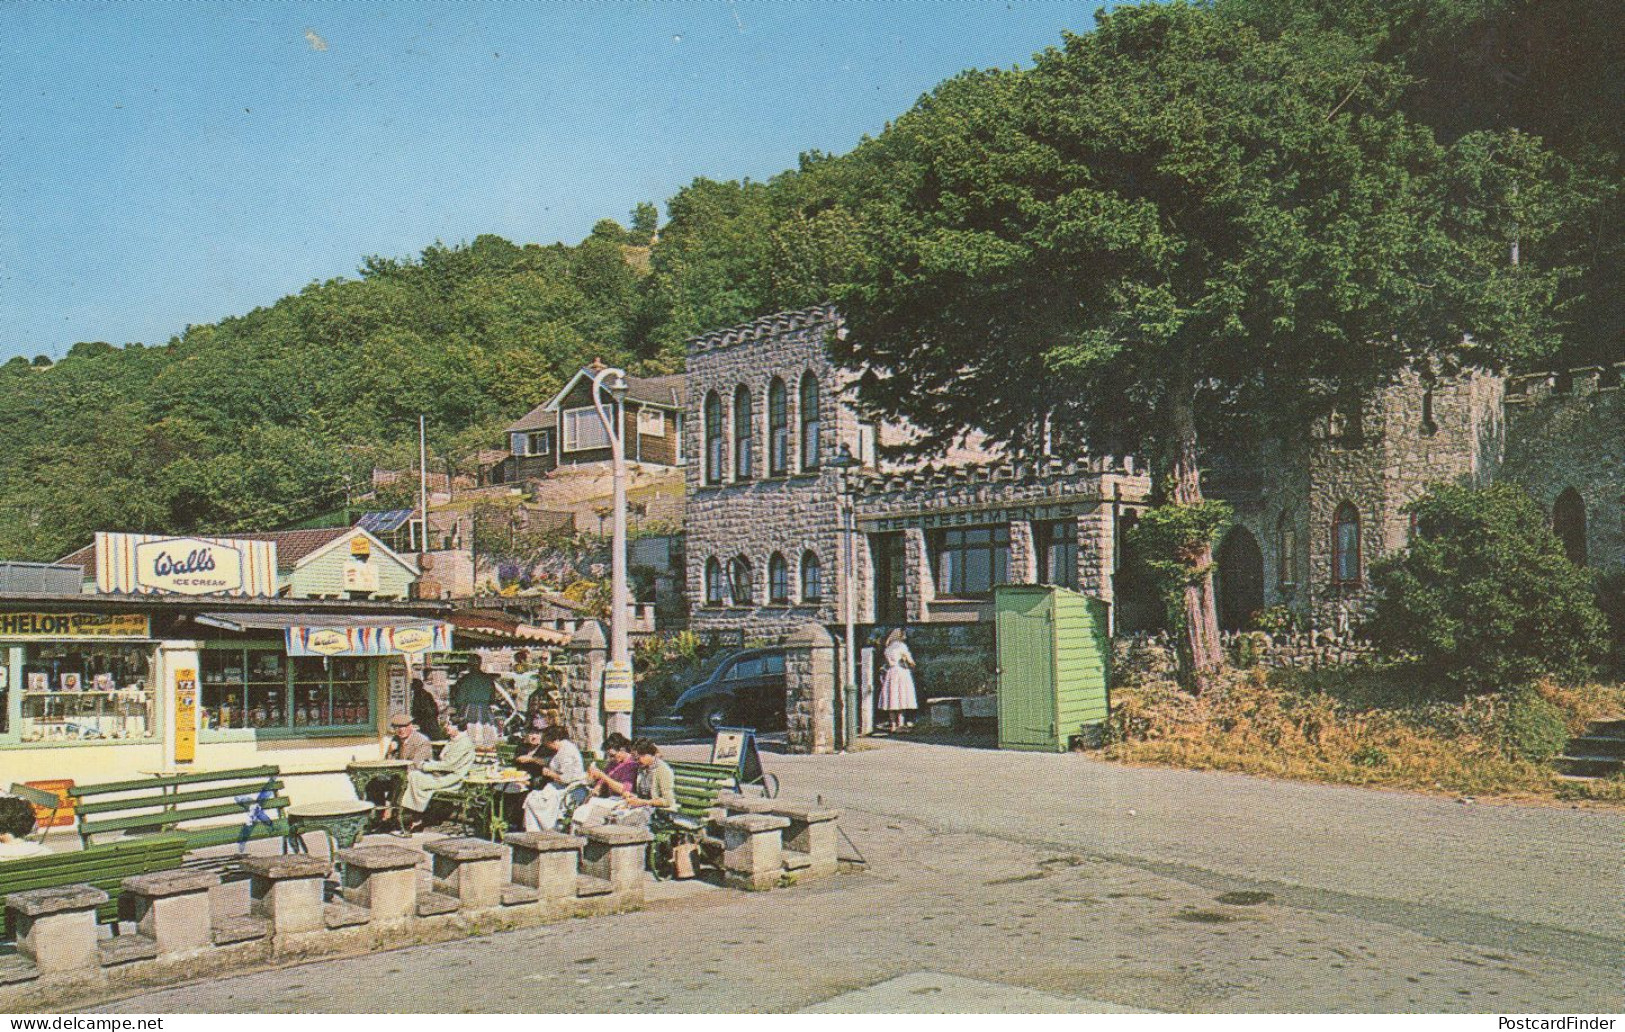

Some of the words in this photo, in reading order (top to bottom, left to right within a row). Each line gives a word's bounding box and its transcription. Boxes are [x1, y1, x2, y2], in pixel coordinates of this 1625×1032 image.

[878, 505, 1073, 531] REFRESHMENTS
[154, 548, 216, 577] Wall's
[172, 579, 190, 587] ICE
[191, 579, 226, 587] CREAM
[0, 615, 70, 634] HELOR
